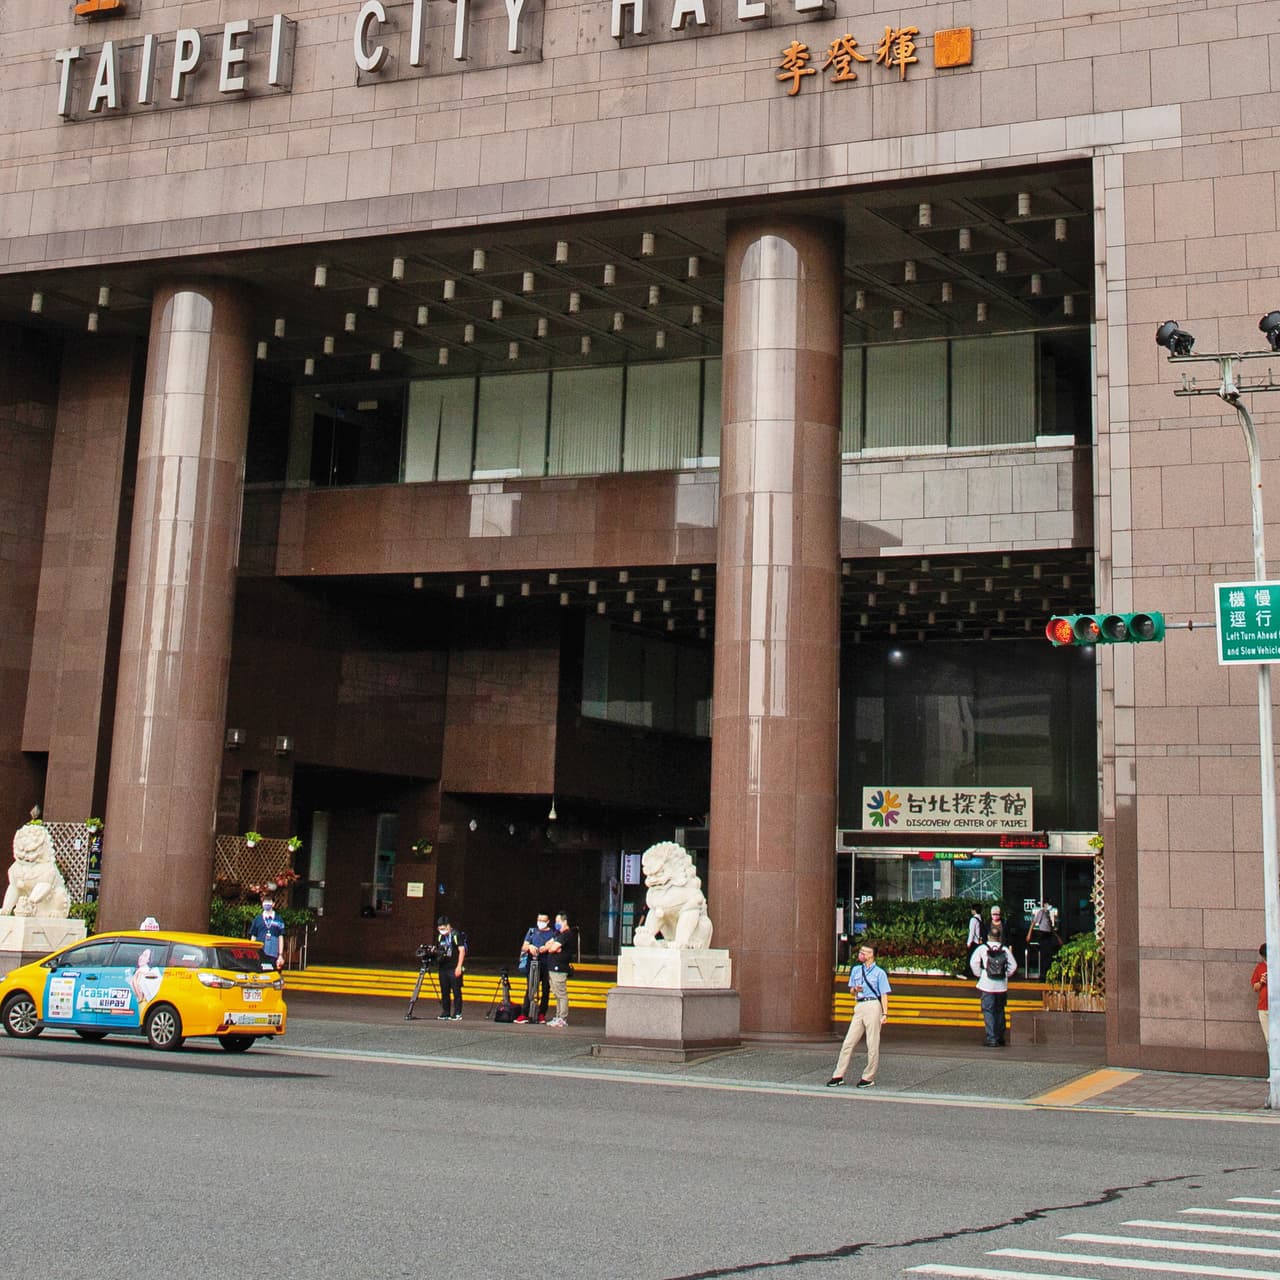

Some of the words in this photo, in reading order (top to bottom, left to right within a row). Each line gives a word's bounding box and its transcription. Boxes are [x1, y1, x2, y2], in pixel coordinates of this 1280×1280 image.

[56, 13, 291, 117] TAIPEI
[776, 25, 919, 96] 李登輝
[1226, 631, 1240, 641] Left
[1240, 631, 1256, 641] Turn
[1257, 630, 1277, 640] Ahead
[1227, 646, 1239, 655] and
[1241, 646, 1256, 655] Slow
[907, 791, 1026, 817] 台北探索館
[906, 819, 950, 827] DISCOVERY
[953, 819, 984, 827] CENTER
[986, 819, 998, 827] OF
[1001, 819, 1027, 827] TAIPEI
